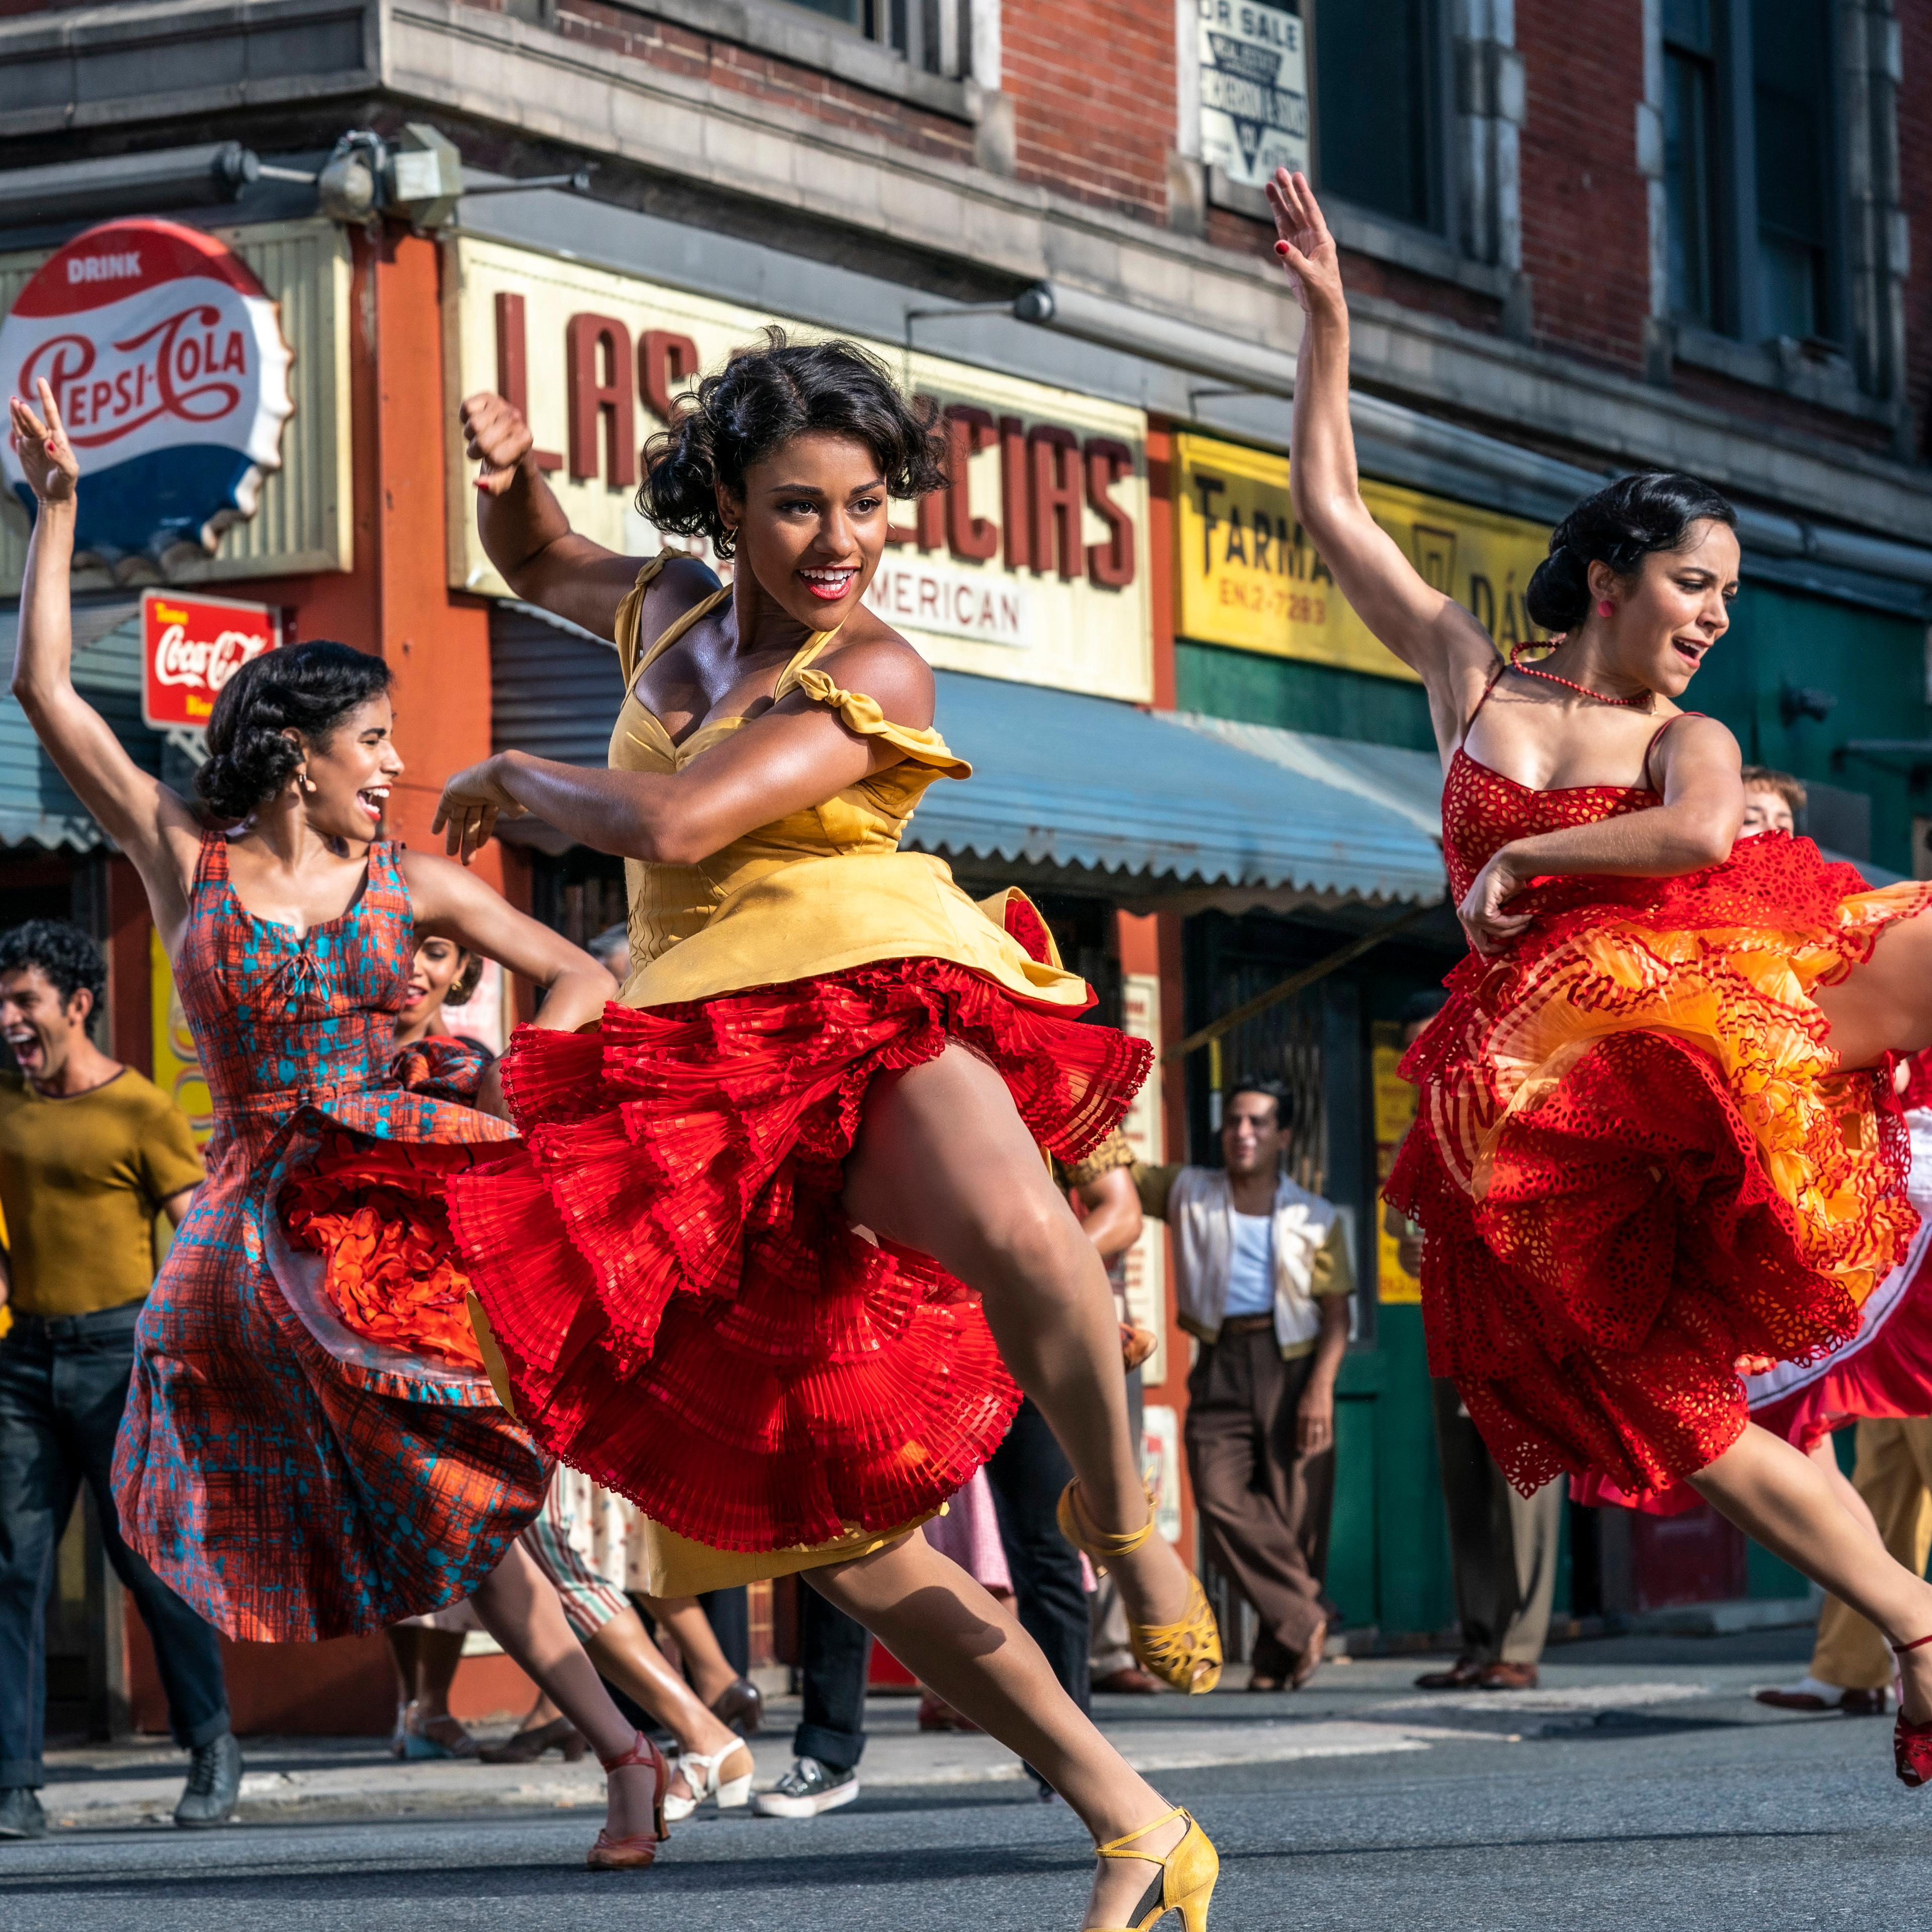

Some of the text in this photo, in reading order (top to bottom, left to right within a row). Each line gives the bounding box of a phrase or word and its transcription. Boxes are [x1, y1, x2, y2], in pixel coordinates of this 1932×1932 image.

[1241, 8, 1297, 52] SALE
[67, 252, 141, 284] DRINK
[869, 571, 1019, 633] MERICAN
